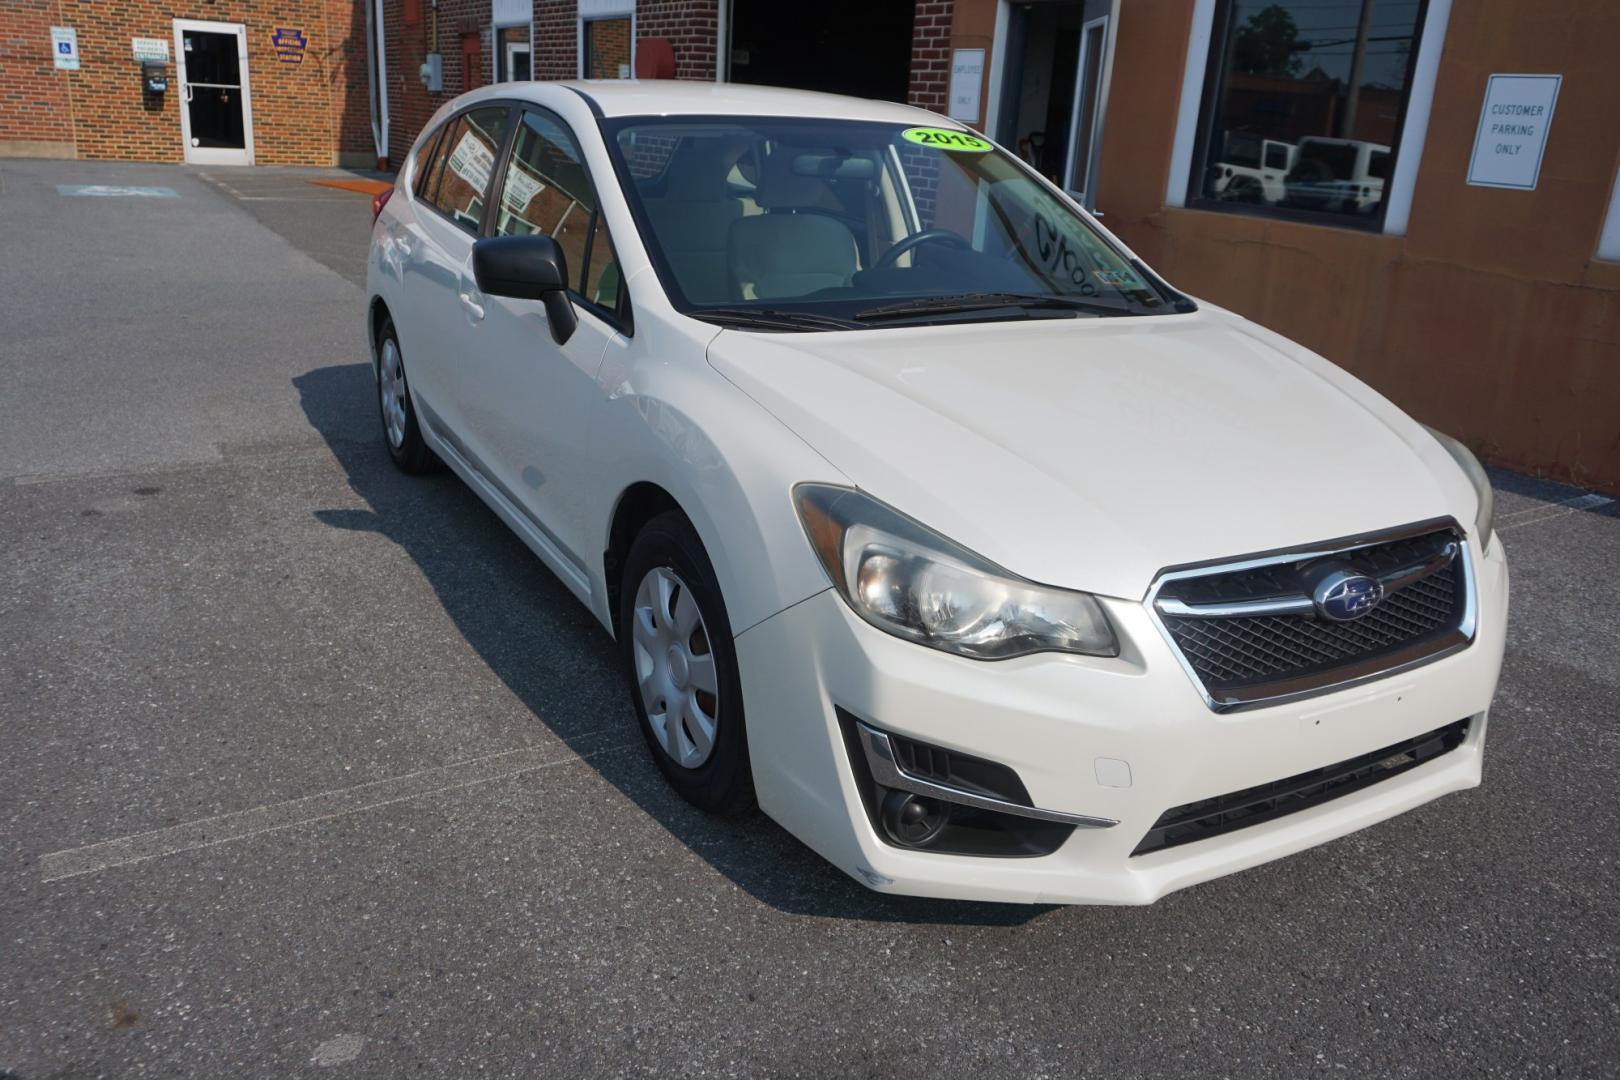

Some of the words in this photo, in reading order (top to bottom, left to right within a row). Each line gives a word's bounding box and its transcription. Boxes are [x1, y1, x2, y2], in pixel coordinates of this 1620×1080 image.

[1491, 104, 1545, 116] CUSTOMER
[1491, 123, 1535, 136] PARKING
[915, 131, 982, 148] 2015
[1495, 143, 1522, 155] ONLY
